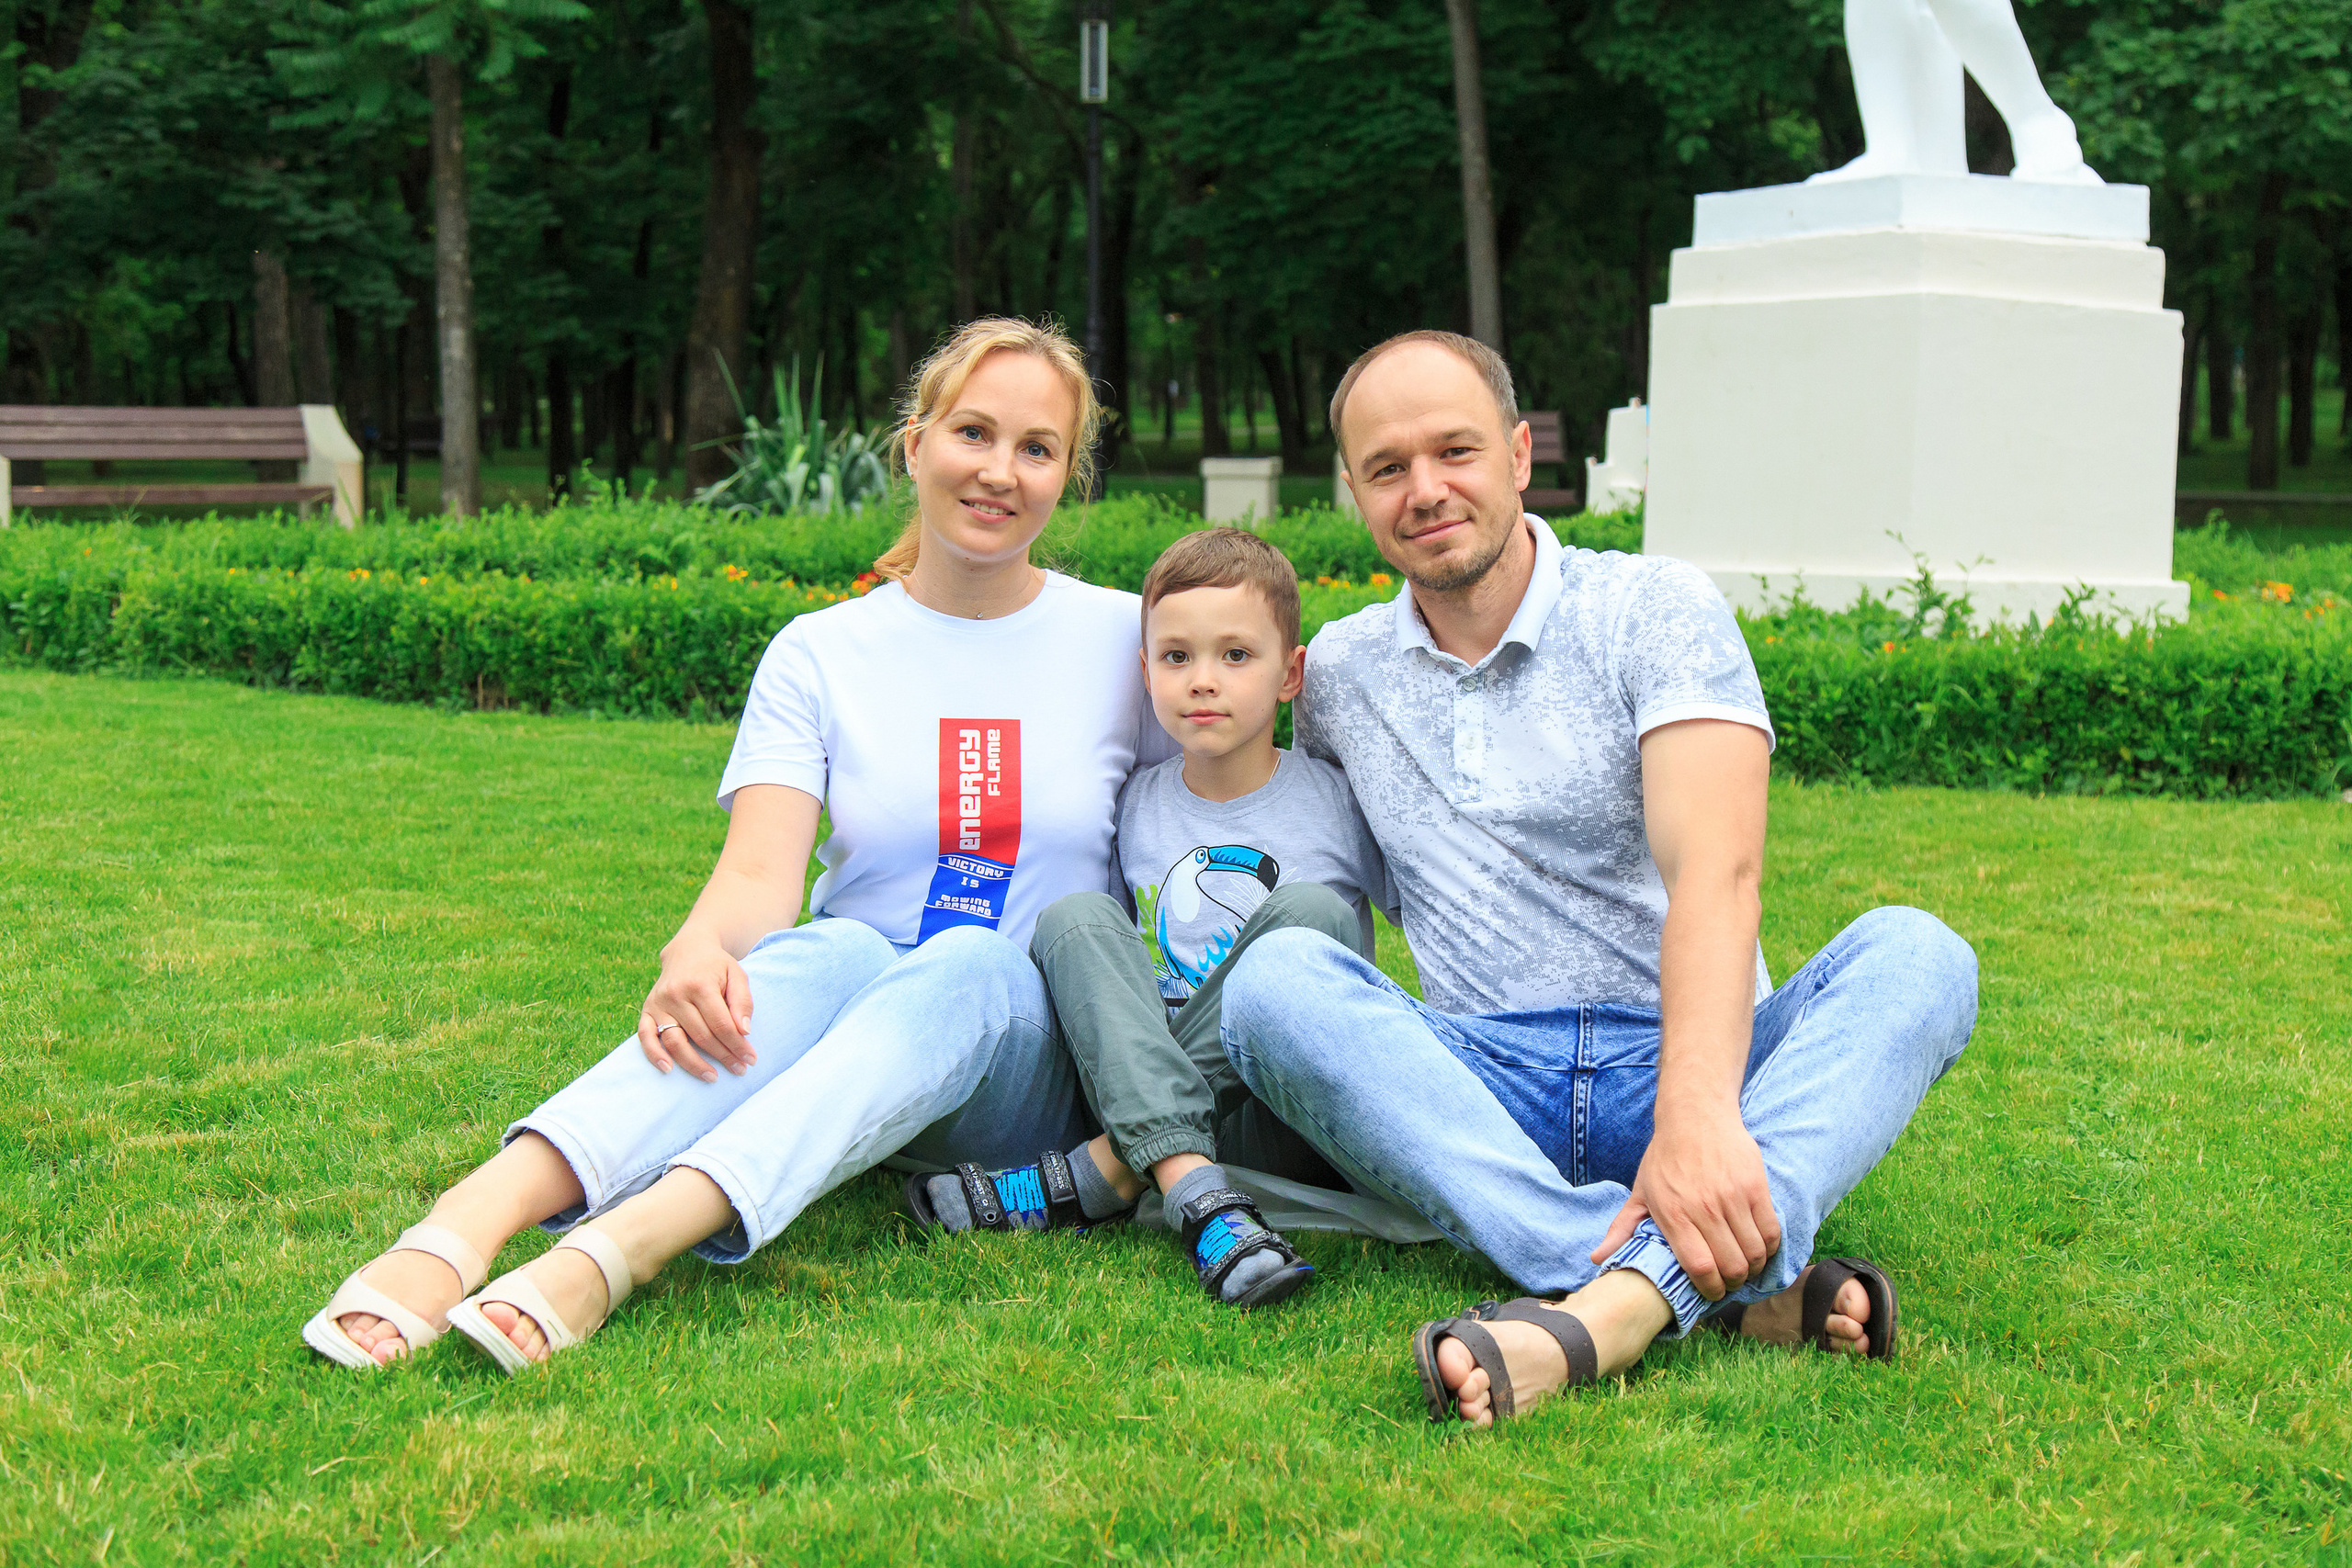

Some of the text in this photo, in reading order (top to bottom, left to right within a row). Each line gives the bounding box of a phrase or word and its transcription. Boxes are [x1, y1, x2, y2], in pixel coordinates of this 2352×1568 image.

[948, 856, 1004, 878] VICTORY
[961, 875, 979, 888] IS
[935, 900, 991, 917] FORWARD
